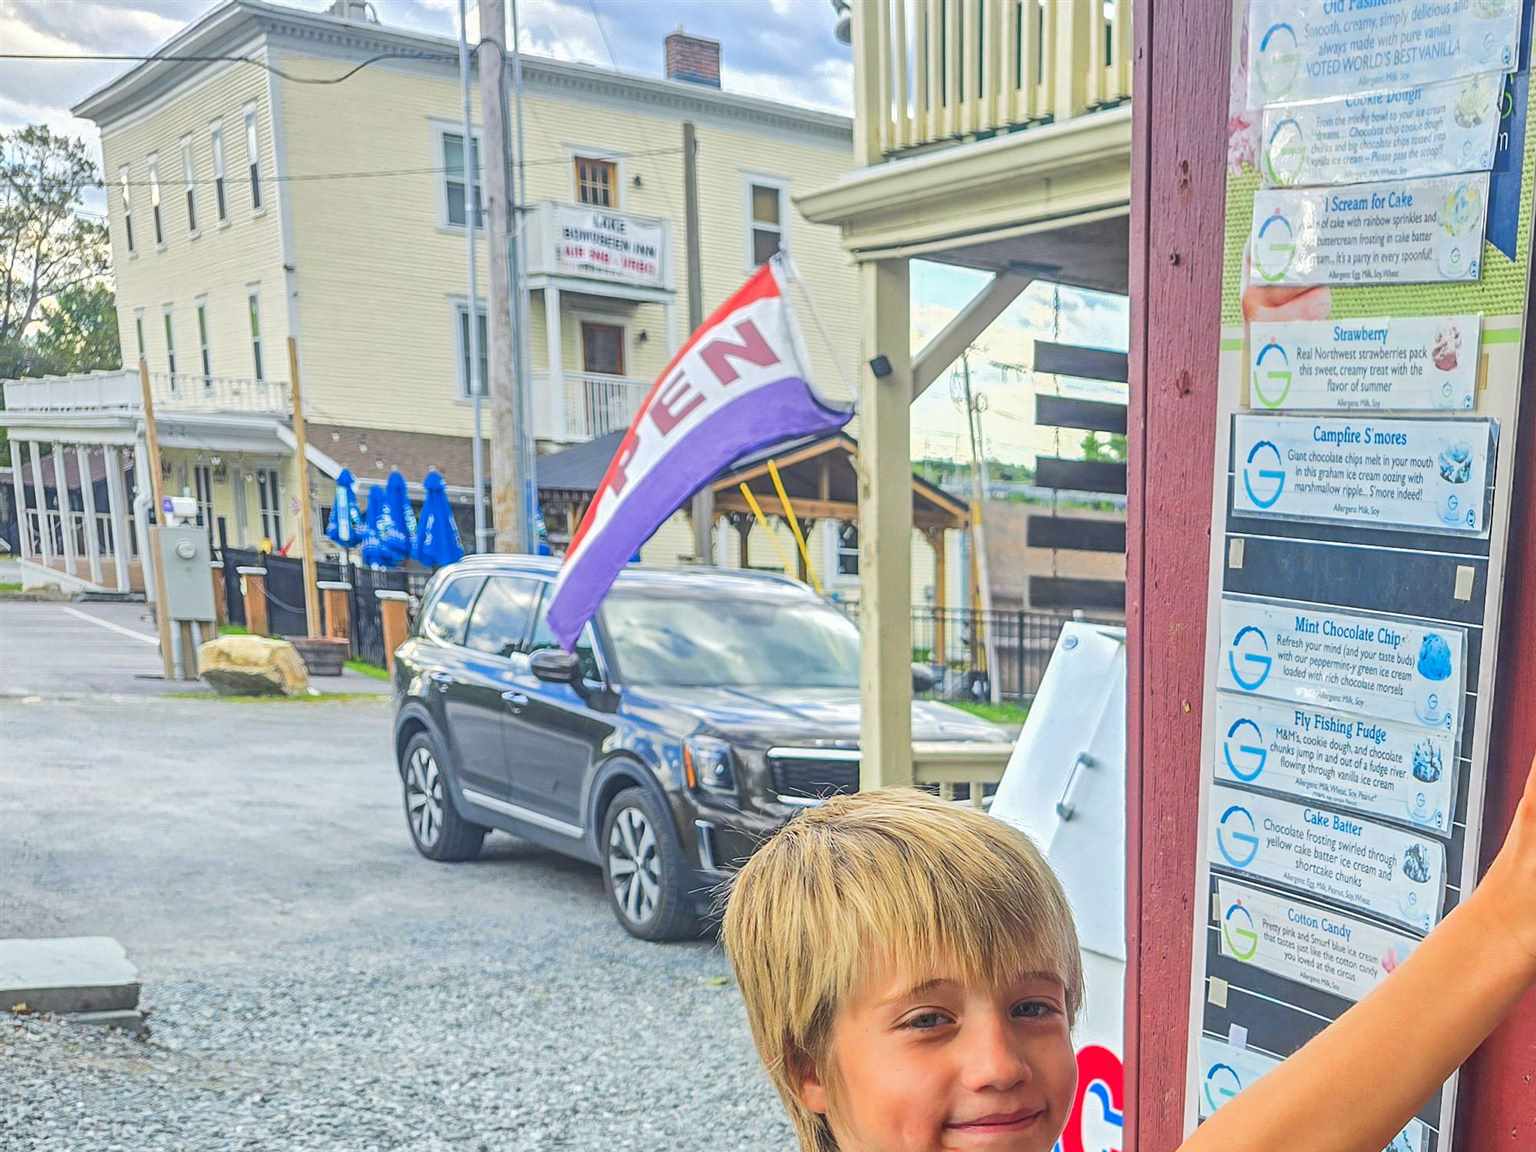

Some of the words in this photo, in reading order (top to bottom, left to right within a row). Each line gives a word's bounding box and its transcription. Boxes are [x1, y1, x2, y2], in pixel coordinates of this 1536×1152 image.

[1343, 52, 1392, 73] WORLD'S
[1394, 47, 1416, 65] BEST
[1331, 195, 1368, 212] Scream
[1371, 192, 1386, 209] for
[1388, 192, 1414, 208] Cake
[1334, 326, 1388, 344] Strawberry
[1296, 347, 1312, 359] Real
[1314, 348, 1356, 359] Northwest
[1359, 347, 1407, 359] strawberries
[1409, 345, 1427, 362] pack
[1340, 366, 1367, 379] creamy
[1390, 364, 1408, 375] with
[1410, 364, 1422, 375] the
[1351, 379, 1360, 392] of
[1361, 382, 1392, 392] summer
[607, 318, 781, 497] PEN
[1314, 425, 1360, 446] Campfire
[1364, 427, 1407, 445] S'mores
[1288, 449, 1307, 460] Giant
[1308, 451, 1342, 464] chocolate
[1345, 452, 1362, 465] chips
[1365, 454, 1381, 465] melt
[1391, 457, 1408, 470] your
[1410, 456, 1433, 468] mouth
[1294, 482, 1340, 494] marshmallow
[1304, 466, 1317, 477] this
[1319, 468, 1345, 480] graham
[1346, 470, 1356, 479] ice
[1358, 472, 1380, 481] cream
[1408, 472, 1424, 484] with
[1295, 616, 1319, 633] Mint
[1323, 620, 1374, 641] Chocolate
[1276, 634, 1303, 648] Refresh
[1305, 641, 1322, 652] your
[1323, 643, 1341, 654] mind
[1360, 648, 1377, 661] your
[1378, 650, 1395, 662] taste
[1277, 650, 1292, 660] with
[1295, 654, 1308, 663] our
[1391, 670, 1412, 681] cream
[1283, 666, 1306, 679] loaded
[1308, 671, 1322, 682] with
[1325, 672, 1338, 683] rich
[1340, 677, 1374, 691] chocolate
[1295, 711, 1311, 731] Fly
[1314, 714, 1353, 739] Fishing
[1356, 722, 1386, 744] Fudge
[1270, 741, 1294, 756] chunks
[1325, 752, 1338, 764] and
[1354, 758, 1363, 769] of
[1303, 735, 1327, 748] cookie
[1355, 745, 1367, 756] and
[1369, 747, 1402, 763] chocolate
[1280, 756, 1306, 775] flowing
[1307, 765, 1336, 780] through
[1373, 778, 1394, 792] cream
[1304, 808, 1329, 827] Cake
[1333, 815, 1362, 837] Batter
[1263, 818, 1304, 839] Chocolate
[1306, 829, 1336, 852] frosting
[1338, 840, 1366, 856] swirled
[1368, 848, 1397, 869] through
[1266, 837, 1292, 849] yellow
[1294, 843, 1312, 856] cake
[1314, 849, 1338, 864] batter
[1353, 861, 1376, 875] cream
[1378, 867, 1392, 881] and
[1295, 858, 1333, 878] shortcake
[1335, 870, 1362, 887] chunks
[1288, 908, 1319, 929] Cotton
[1321, 918, 1351, 942] Candy
